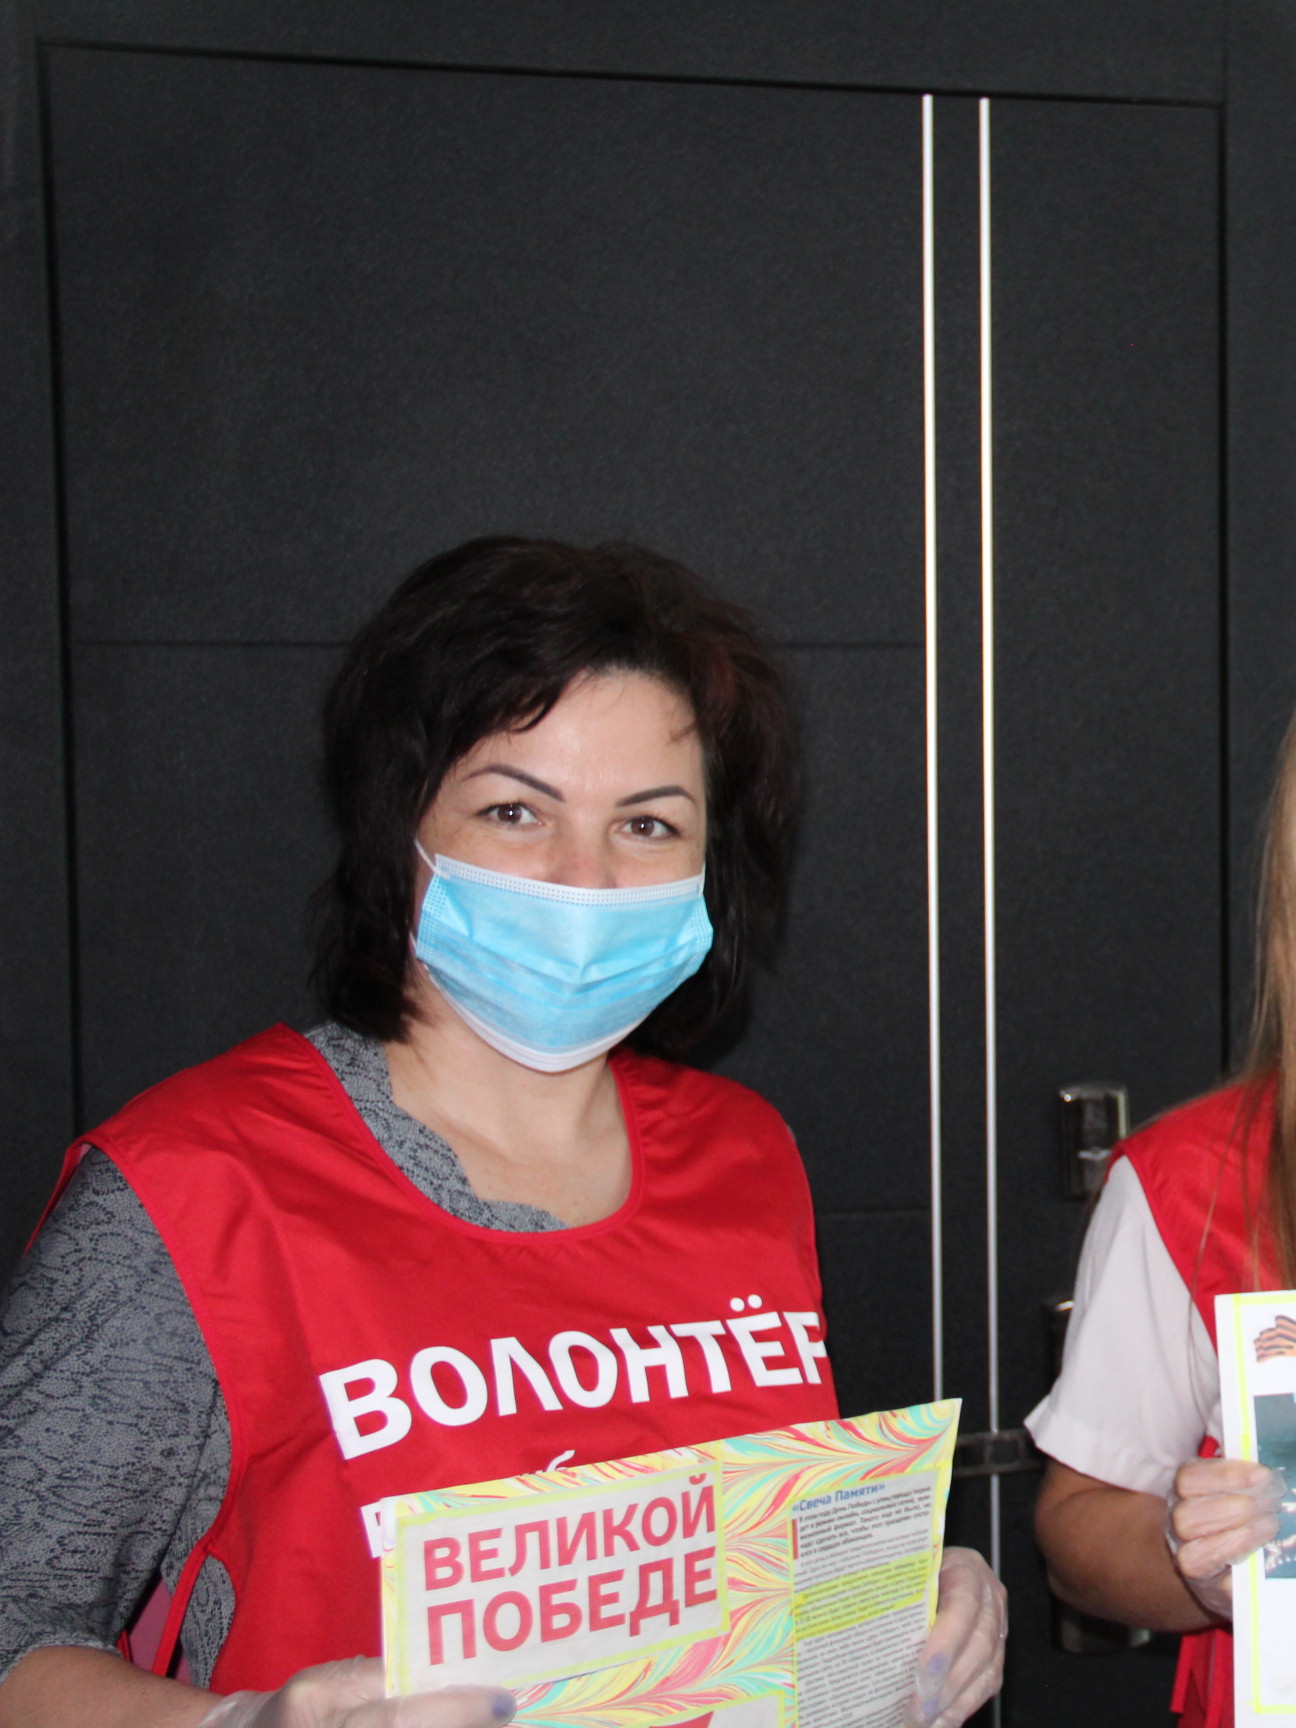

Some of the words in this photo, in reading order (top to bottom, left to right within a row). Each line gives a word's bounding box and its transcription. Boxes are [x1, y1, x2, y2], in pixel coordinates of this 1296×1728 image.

[319, 1293, 829, 1461] ВОЛОНТЁР
[423, 1472, 716, 1592] ВЕЛИКОЙ
[792, 1495, 832, 1512] «Свеча
[835, 1483, 886, 1502] Памяти»
[426, 1546, 720, 1667] ПОБЕДЕ
